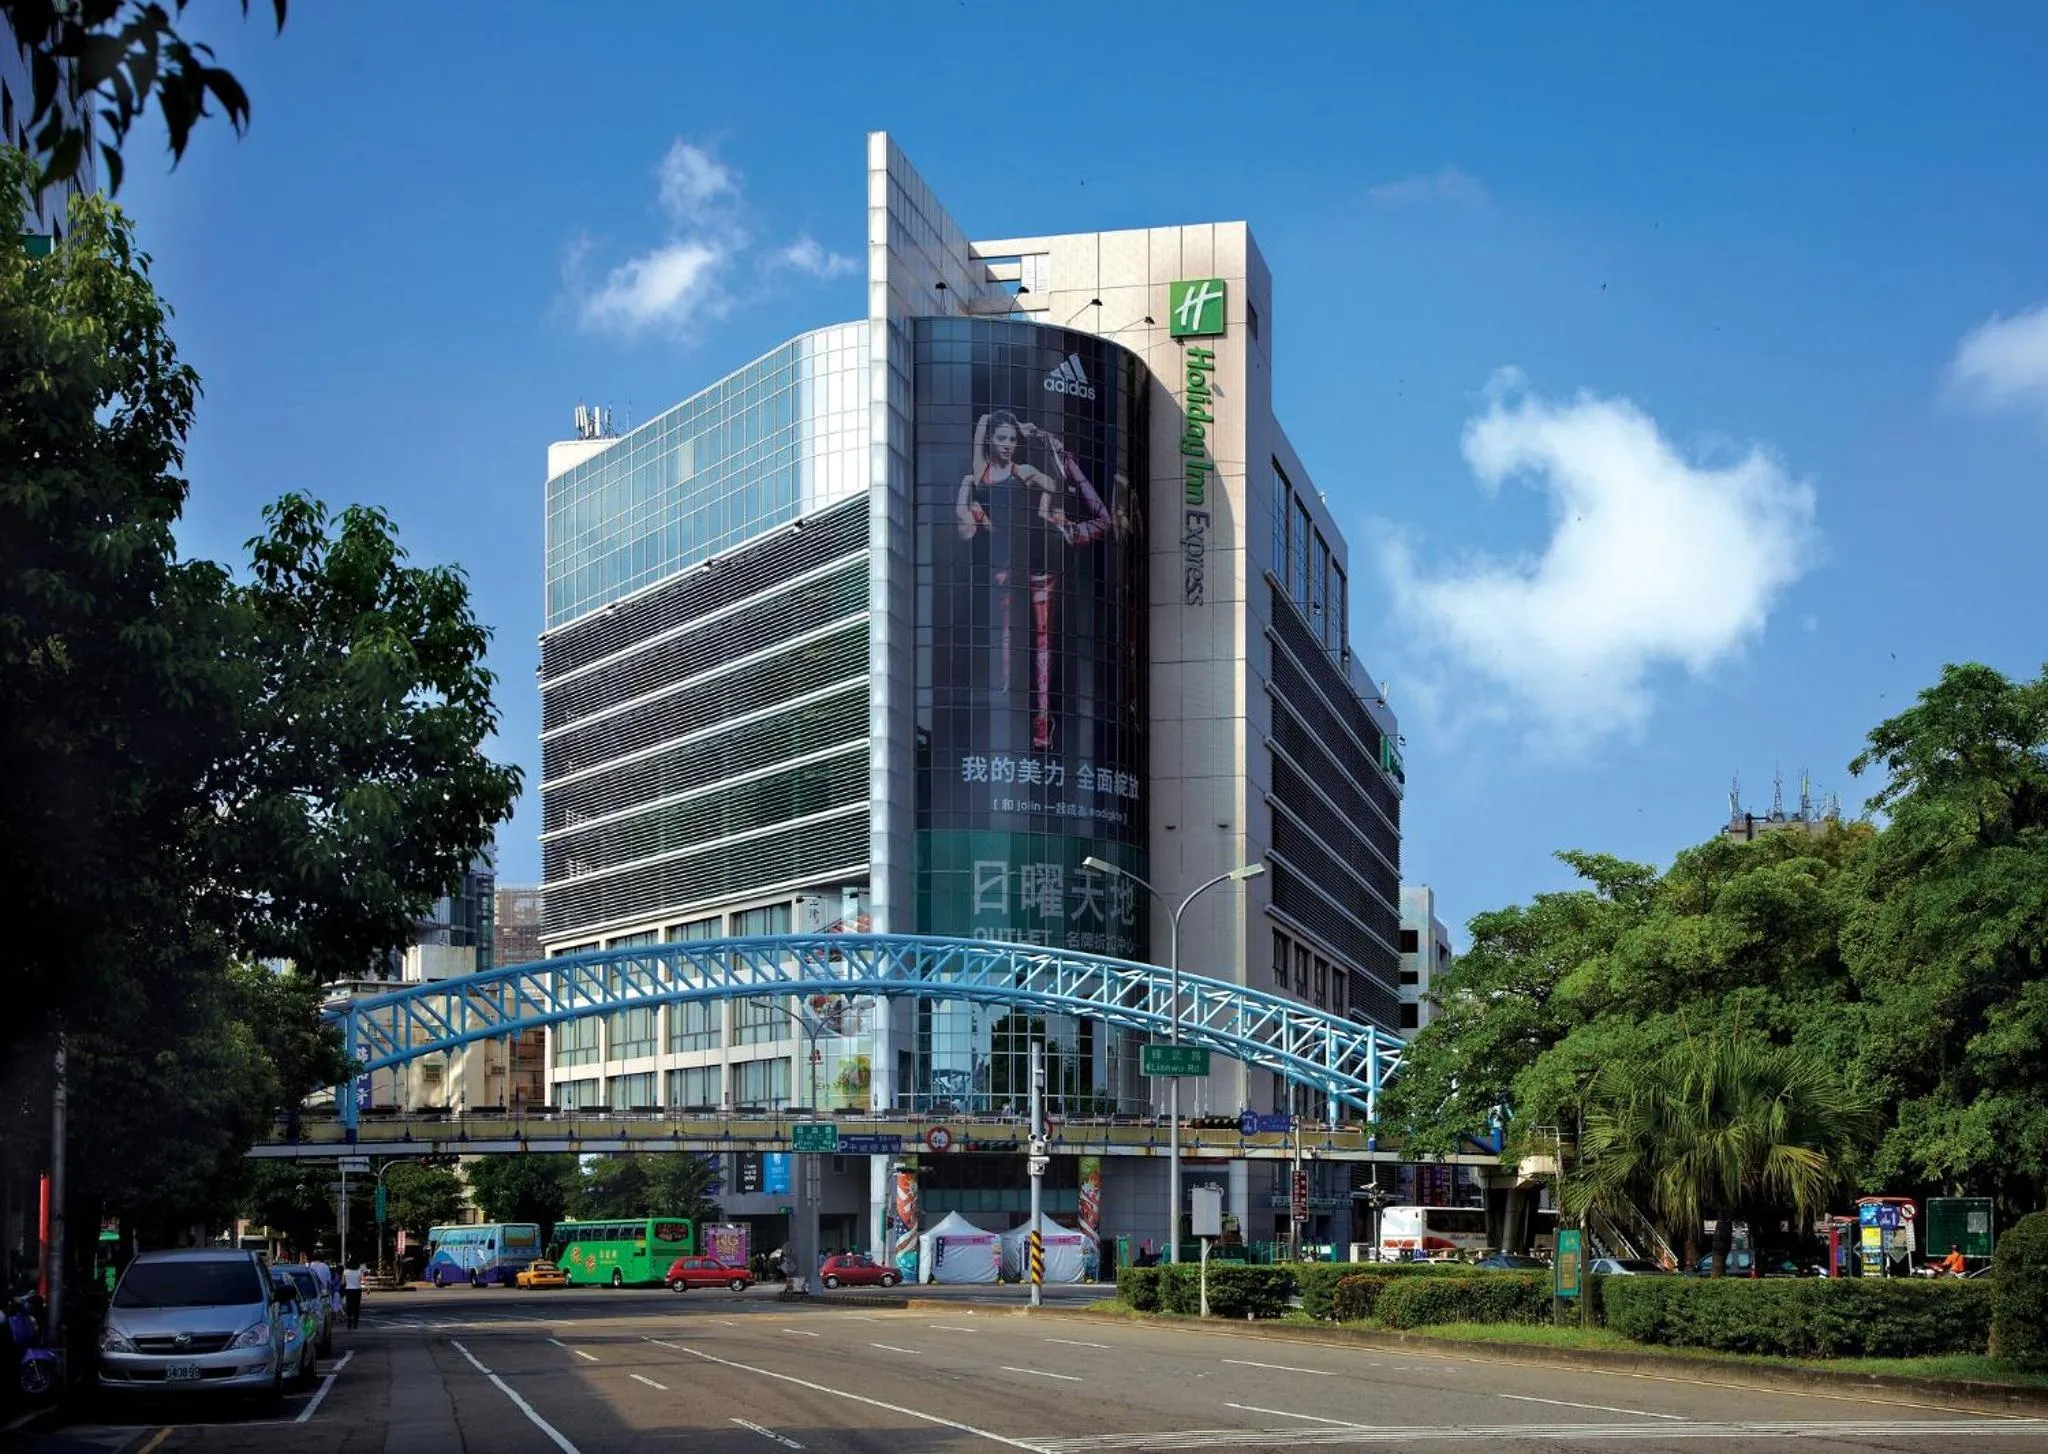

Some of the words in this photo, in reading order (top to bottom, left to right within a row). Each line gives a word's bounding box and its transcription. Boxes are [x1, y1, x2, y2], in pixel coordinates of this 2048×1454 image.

[1043, 378, 1096, 400] adidas
[1180, 346, 1215, 457] Holiday
[1185, 460, 1214, 505] Inn
[1180, 509, 1210, 606] Express
[962, 756, 1065, 787] 我的美力
[973, 860, 1136, 926] 日曜天地
[974, 927, 1053, 946] OUTLET
